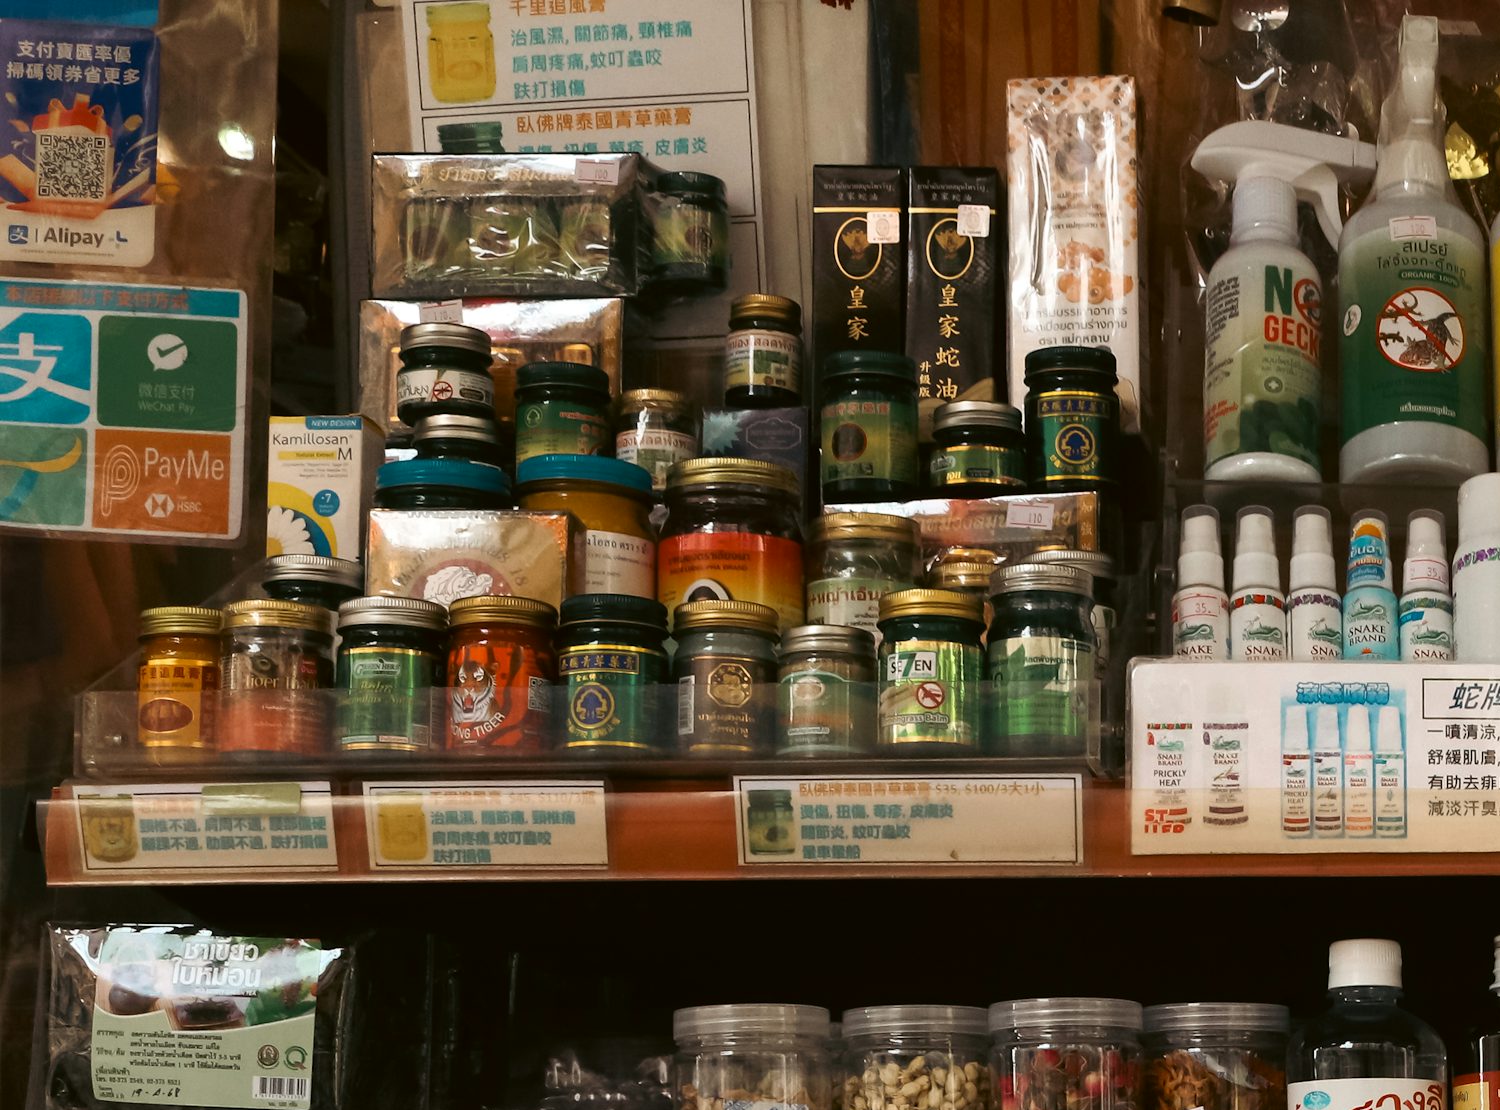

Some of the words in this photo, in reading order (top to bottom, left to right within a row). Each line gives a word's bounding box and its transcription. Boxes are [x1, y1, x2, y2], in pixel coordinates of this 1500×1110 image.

[17, 41, 131, 64] 支付寶匯率優
[6, 61, 140, 86] 掃碼領券省更多
[44, 227, 103, 248] Alipay
[936, 283, 961, 400] 皇家蛇油
[138, 383, 195, 400] 微信支付
[179, 402, 196, 415] Pay
[272, 434, 349, 446] Kamillosan
[337, 447, 353, 461] M
[144, 448, 225, 485] PayMe
[177, 500, 202, 513] HSBC
[1427, 724, 1500, 742] 一噴清涼,
[1428, 749, 1500, 766] 舒緩肌膚,
